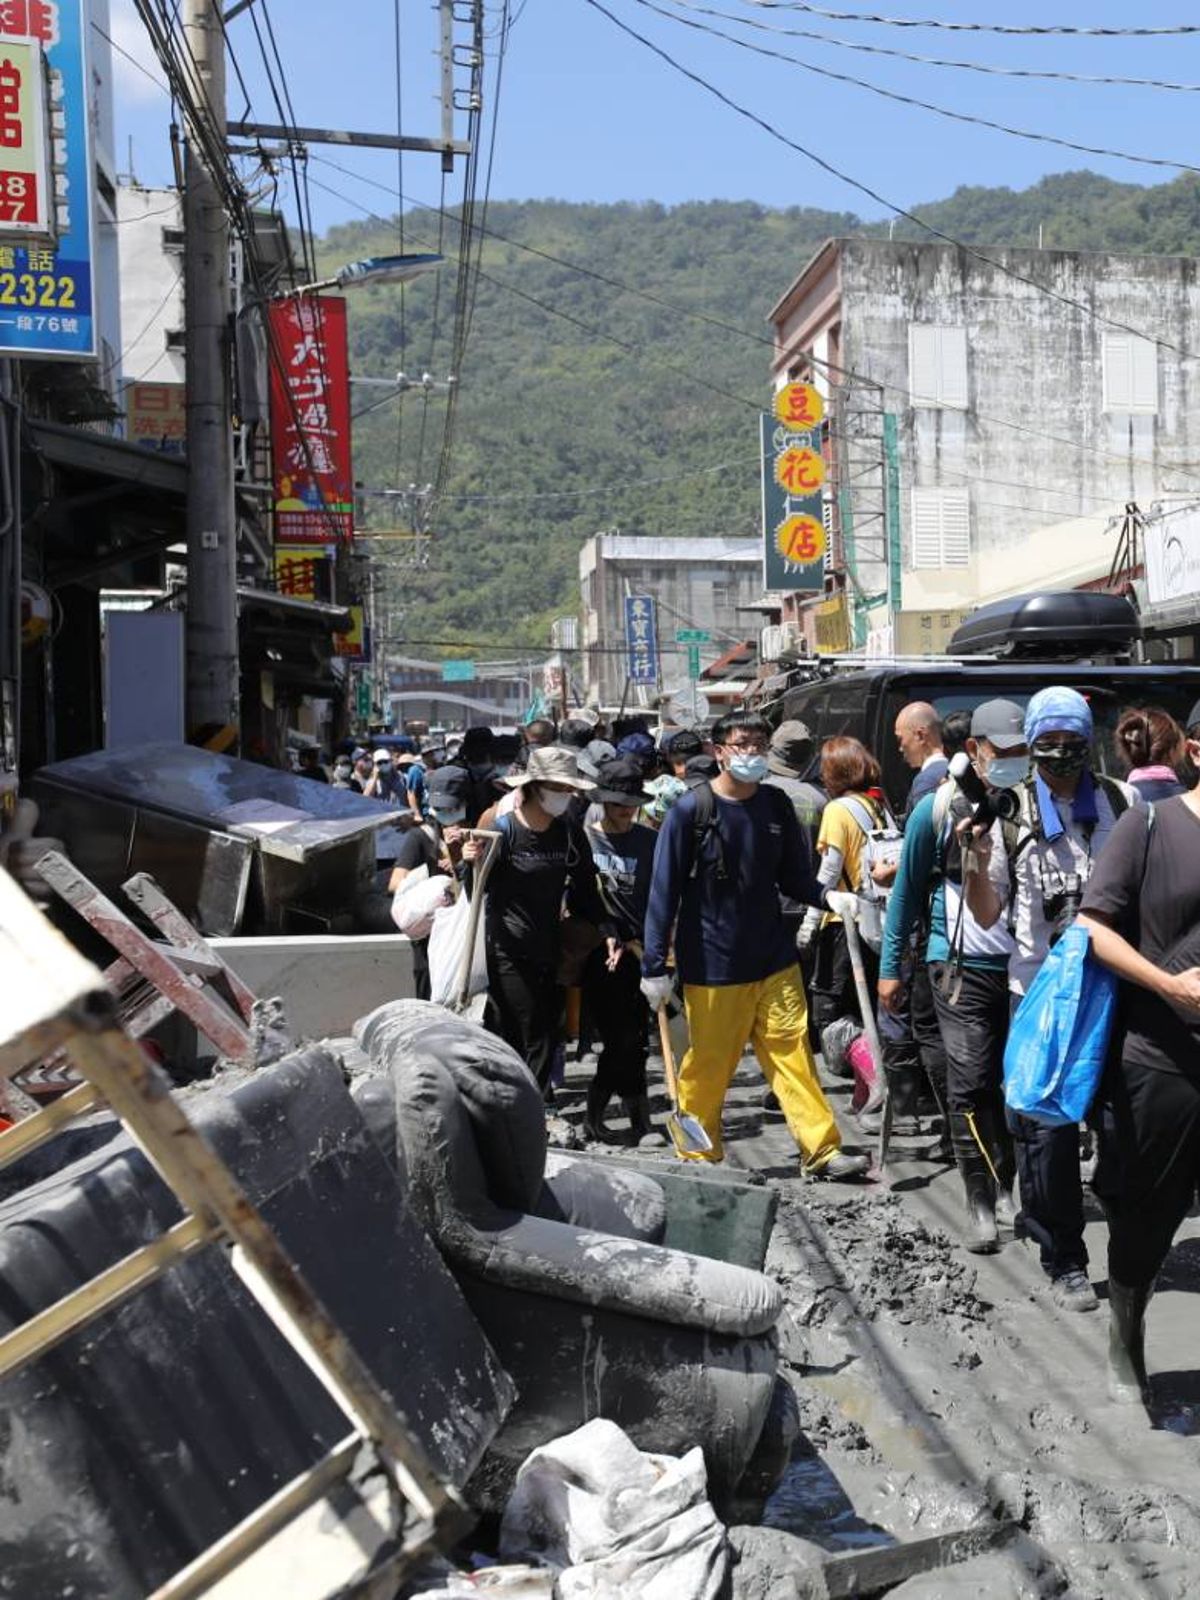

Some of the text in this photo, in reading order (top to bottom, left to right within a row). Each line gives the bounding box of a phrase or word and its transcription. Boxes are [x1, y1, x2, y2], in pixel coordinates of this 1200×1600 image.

[0, 272, 75, 308] 2322
[782, 386, 820, 559] 豆花店
